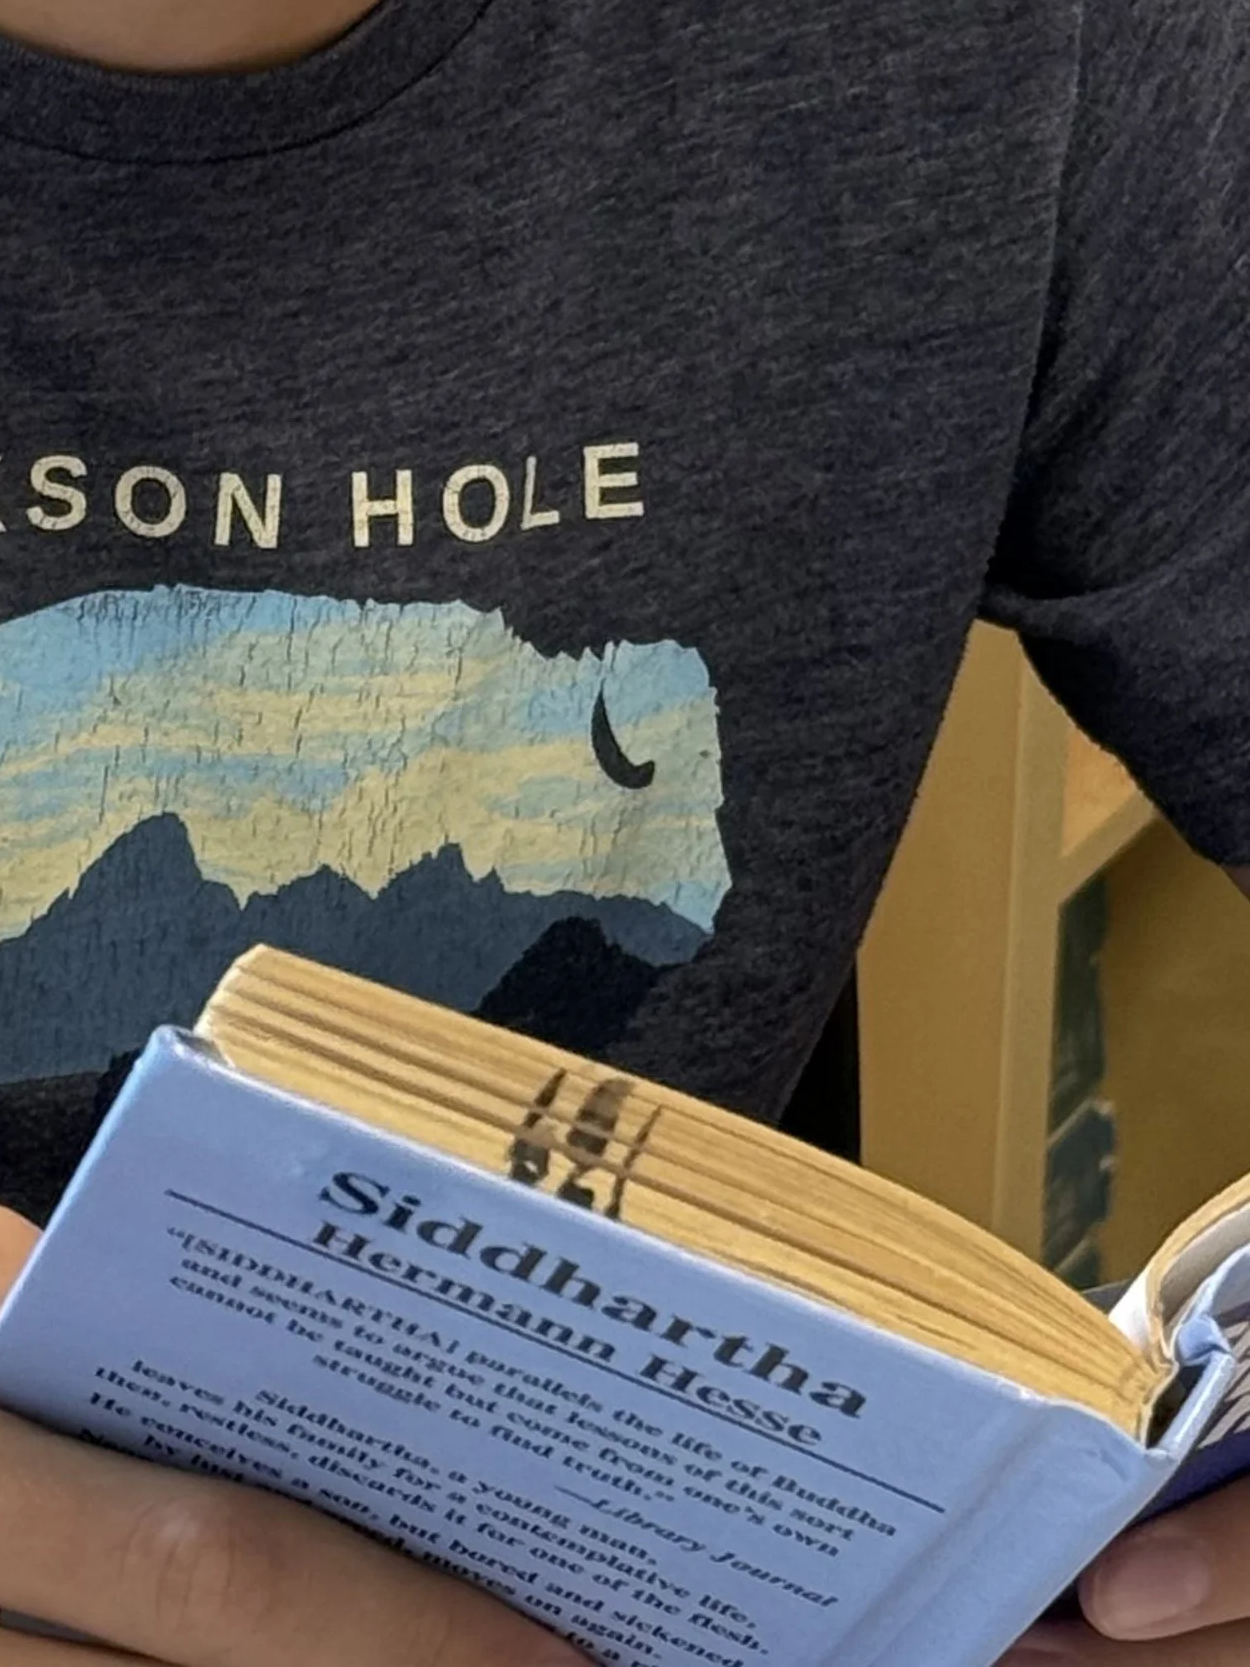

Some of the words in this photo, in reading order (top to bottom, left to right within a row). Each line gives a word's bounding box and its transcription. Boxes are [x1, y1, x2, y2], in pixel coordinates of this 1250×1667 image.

[352, 440, 645, 548] HOLE
[311, 1219, 616, 1363] Hermann
[638, 1353, 822, 1446] Hesse
[317, 1171, 867, 1419] Siddhartha
[130, 1358, 225, 1406] leaves
[231, 1399, 278, 1427] his
[285, 1422, 385, 1471] family
[391, 1466, 442, 1491] for
[445, 1491, 467, 1505] a
[475, 1502, 691, 1599] contemplative
[168, 1275, 276, 1324] cannot
[285, 1317, 324, 1342] be
[332, 1338, 436, 1389] taught
[443, 1382, 498, 1414] but
[505, 1411, 590, 1451] come
[597, 1446, 675, 1487] from
[771, 1523, 839, 1557] own
[180, 1258, 243, 1289] and
[248, 1285, 343, 1329] seems
[352, 1324, 384, 1345] to
[391, 1342, 485, 1386] argue
[492, 1381, 558, 1415] that
[564, 1410, 678, 1466] lessons
[682, 1463, 723, 1482] of
[723, 1478, 783, 1511] this
[789, 1507, 854, 1541] sort
[312, 1354, 441, 1412] struggle
[448, 1408, 480, 1428] to
[489, 1424, 555, 1459] find
[463, 1349, 603, 1413] parallels
[611, 1409, 663, 1436] the
[670, 1431, 722, 1461] life
[729, 1460, 768, 1479] of
[770, 1474, 897, 1536] Buddha
[88, 1391, 131, 1417] He
[139, 1415, 282, 1479] conceives
[289, 1476, 310, 1490] a
[388, 1512, 442, 1545] but
[447, 1538, 539, 1585] bored
[543, 1581, 605, 1613] and
[609, 1609, 744, 1667] sickened
[144, 1433, 179, 1456] by
[523, 1593, 563, 1617] on
[306, 1454, 437, 1513] discards
[442, 1507, 467, 1526] it
[475, 1521, 526, 1547] for
[528, 1546, 585, 1574] one
[590, 1573, 630, 1592] of
[630, 1588, 682, 1615] the
[447, 1469, 468, 1484] a
[470, 1479, 571, 1530] young
[577, 1523, 657, 1566] man,
[708, 1551, 838, 1607] Journal
